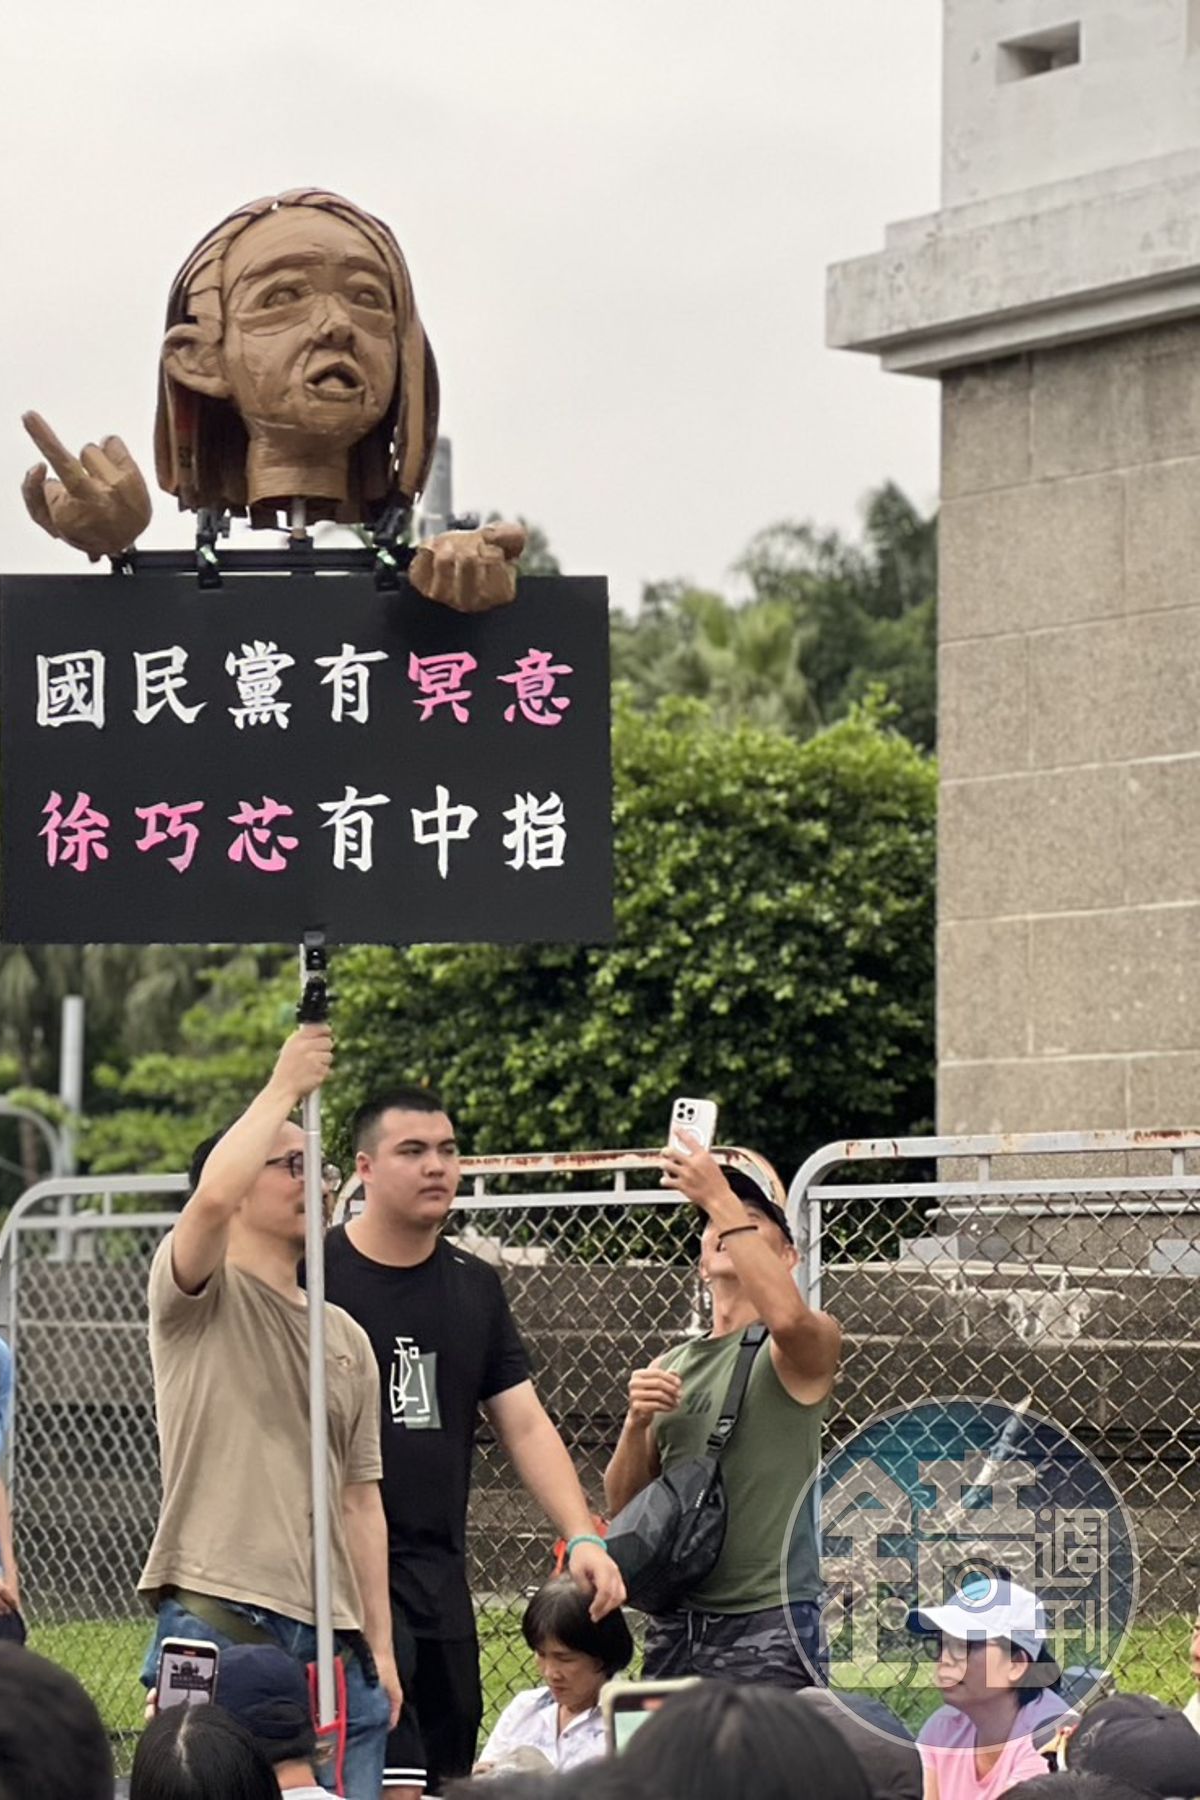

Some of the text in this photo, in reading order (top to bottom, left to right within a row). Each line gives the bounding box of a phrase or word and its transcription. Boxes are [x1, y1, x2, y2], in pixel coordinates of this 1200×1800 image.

[36, 639, 573, 729] 國民黨有冥意
[37, 784, 567, 879] 徐巧芯有中指
